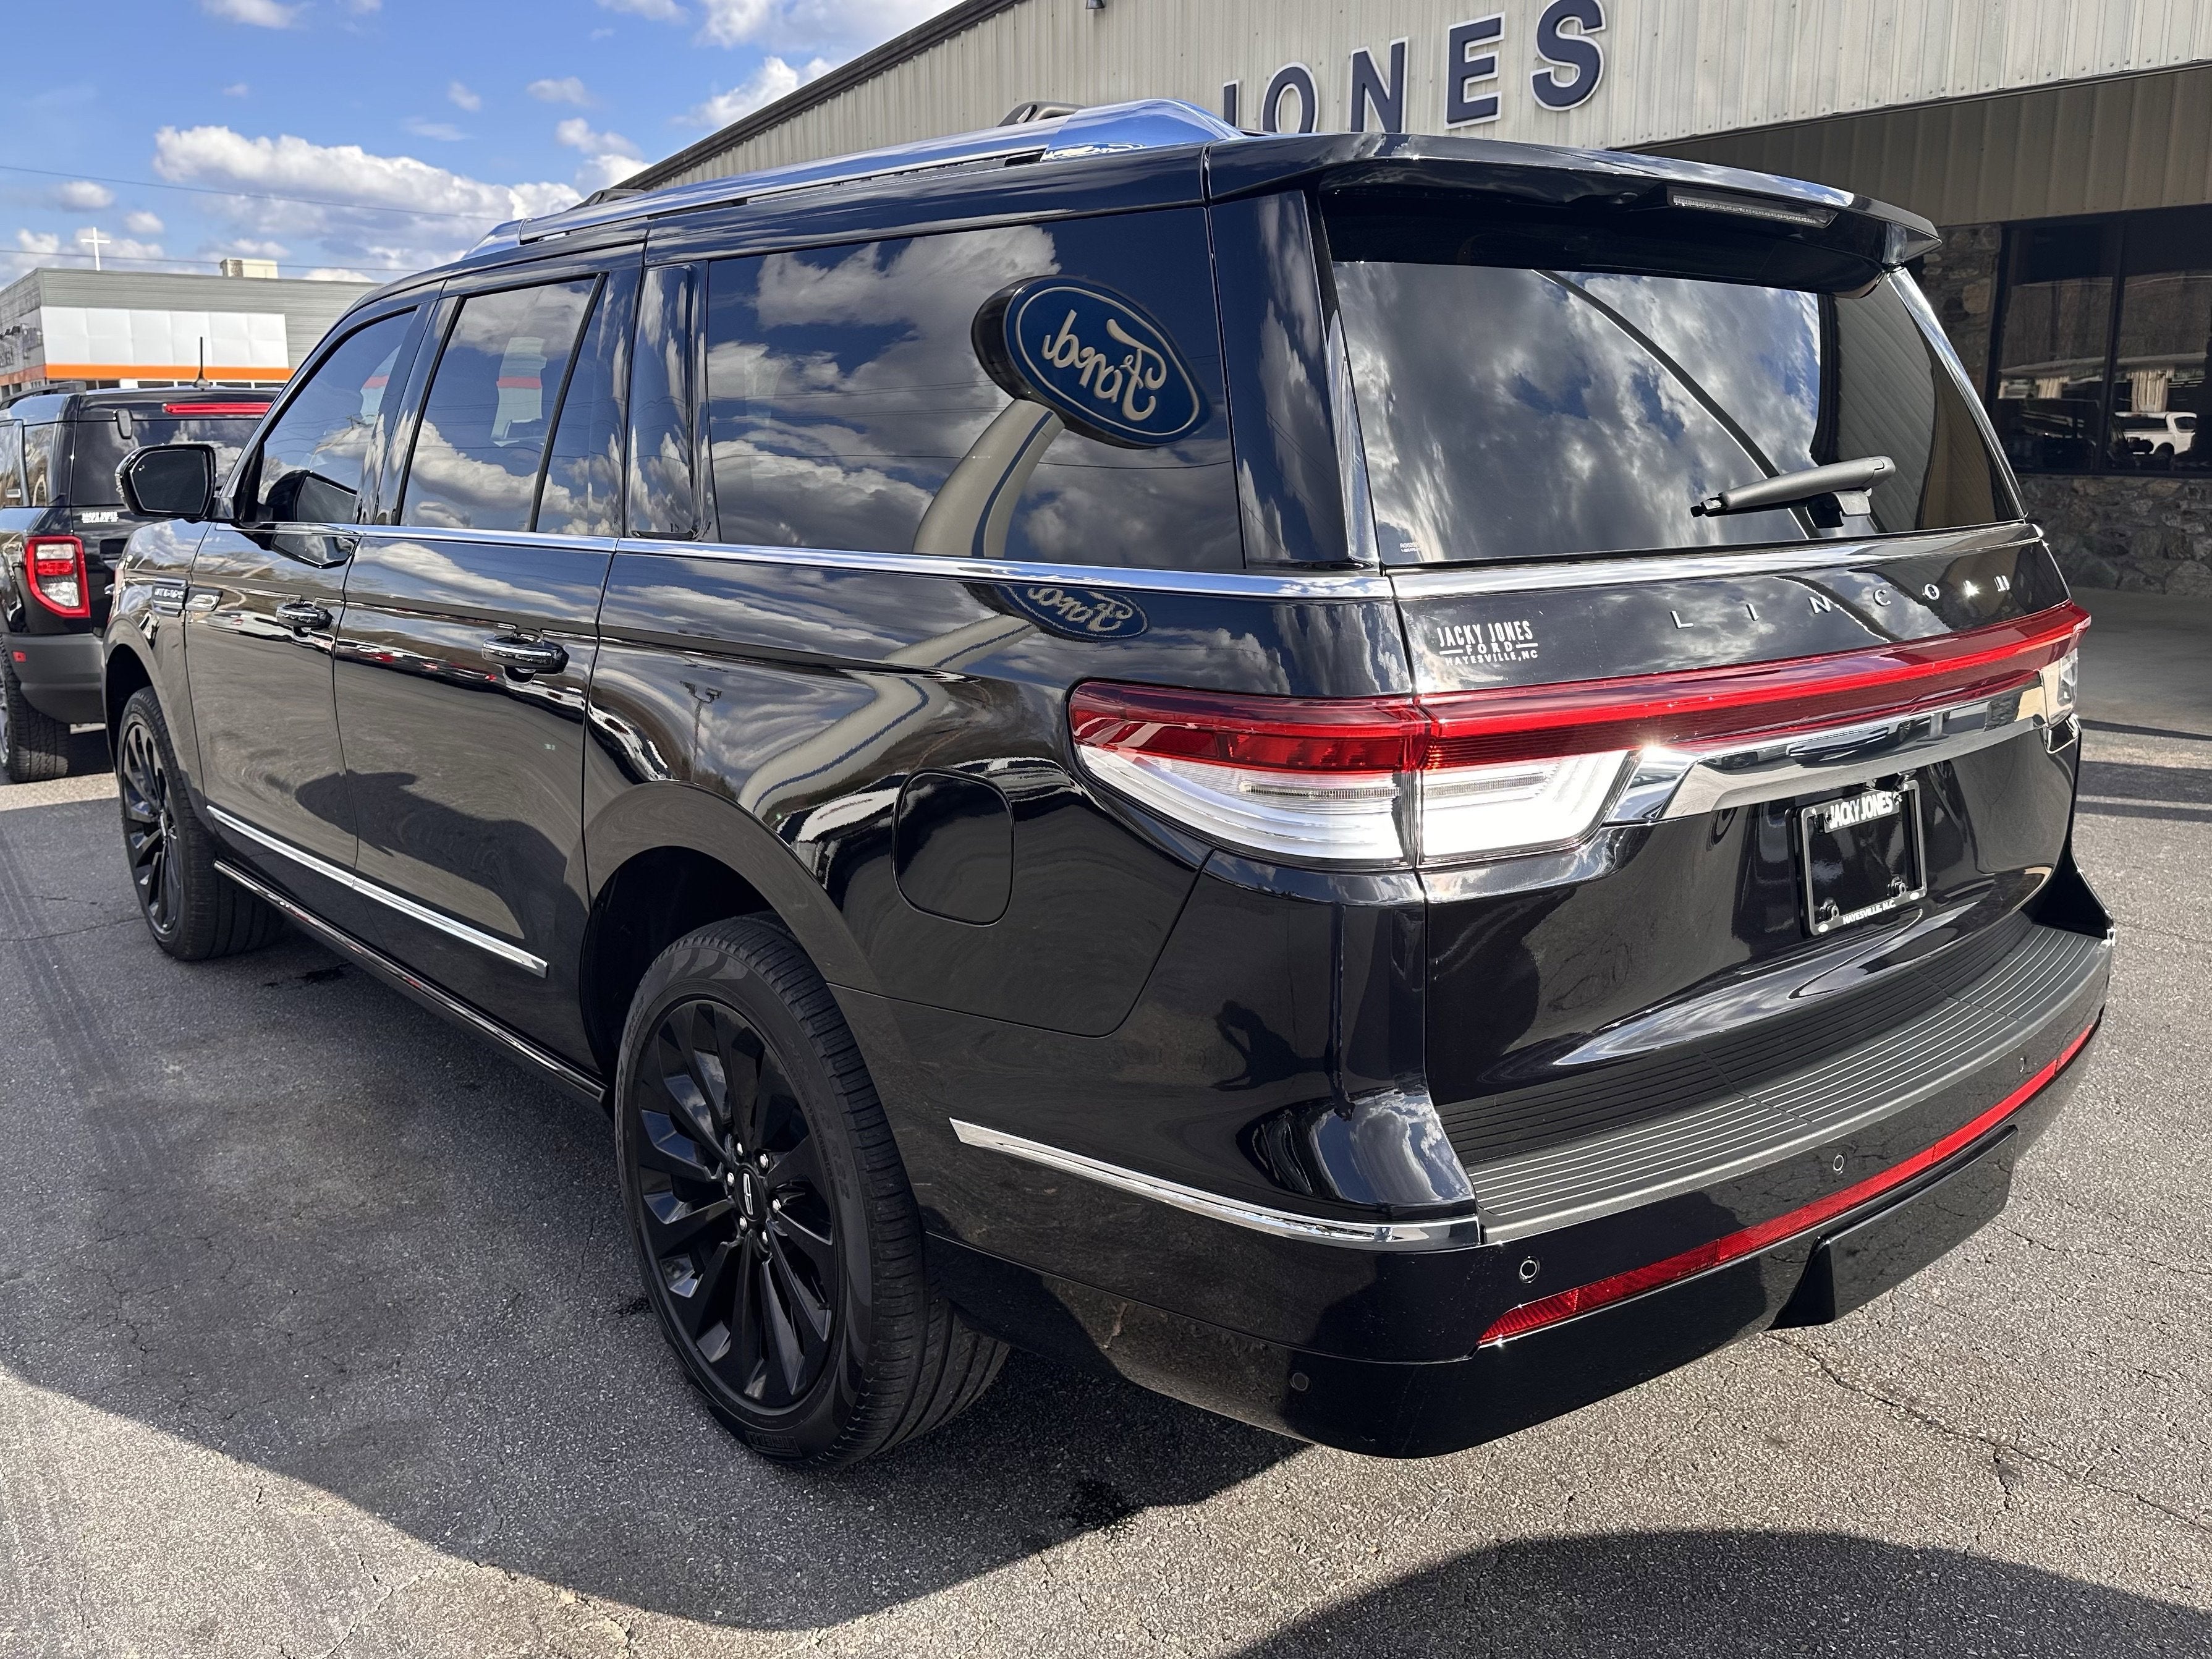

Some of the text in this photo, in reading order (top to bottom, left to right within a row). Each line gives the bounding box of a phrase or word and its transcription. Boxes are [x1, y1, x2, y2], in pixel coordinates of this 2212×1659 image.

[1436, 620, 1533, 647] JACKY JONES
[1465, 641, 1514, 655] FORD
[1829, 791, 1893, 830] JACKY JONES
